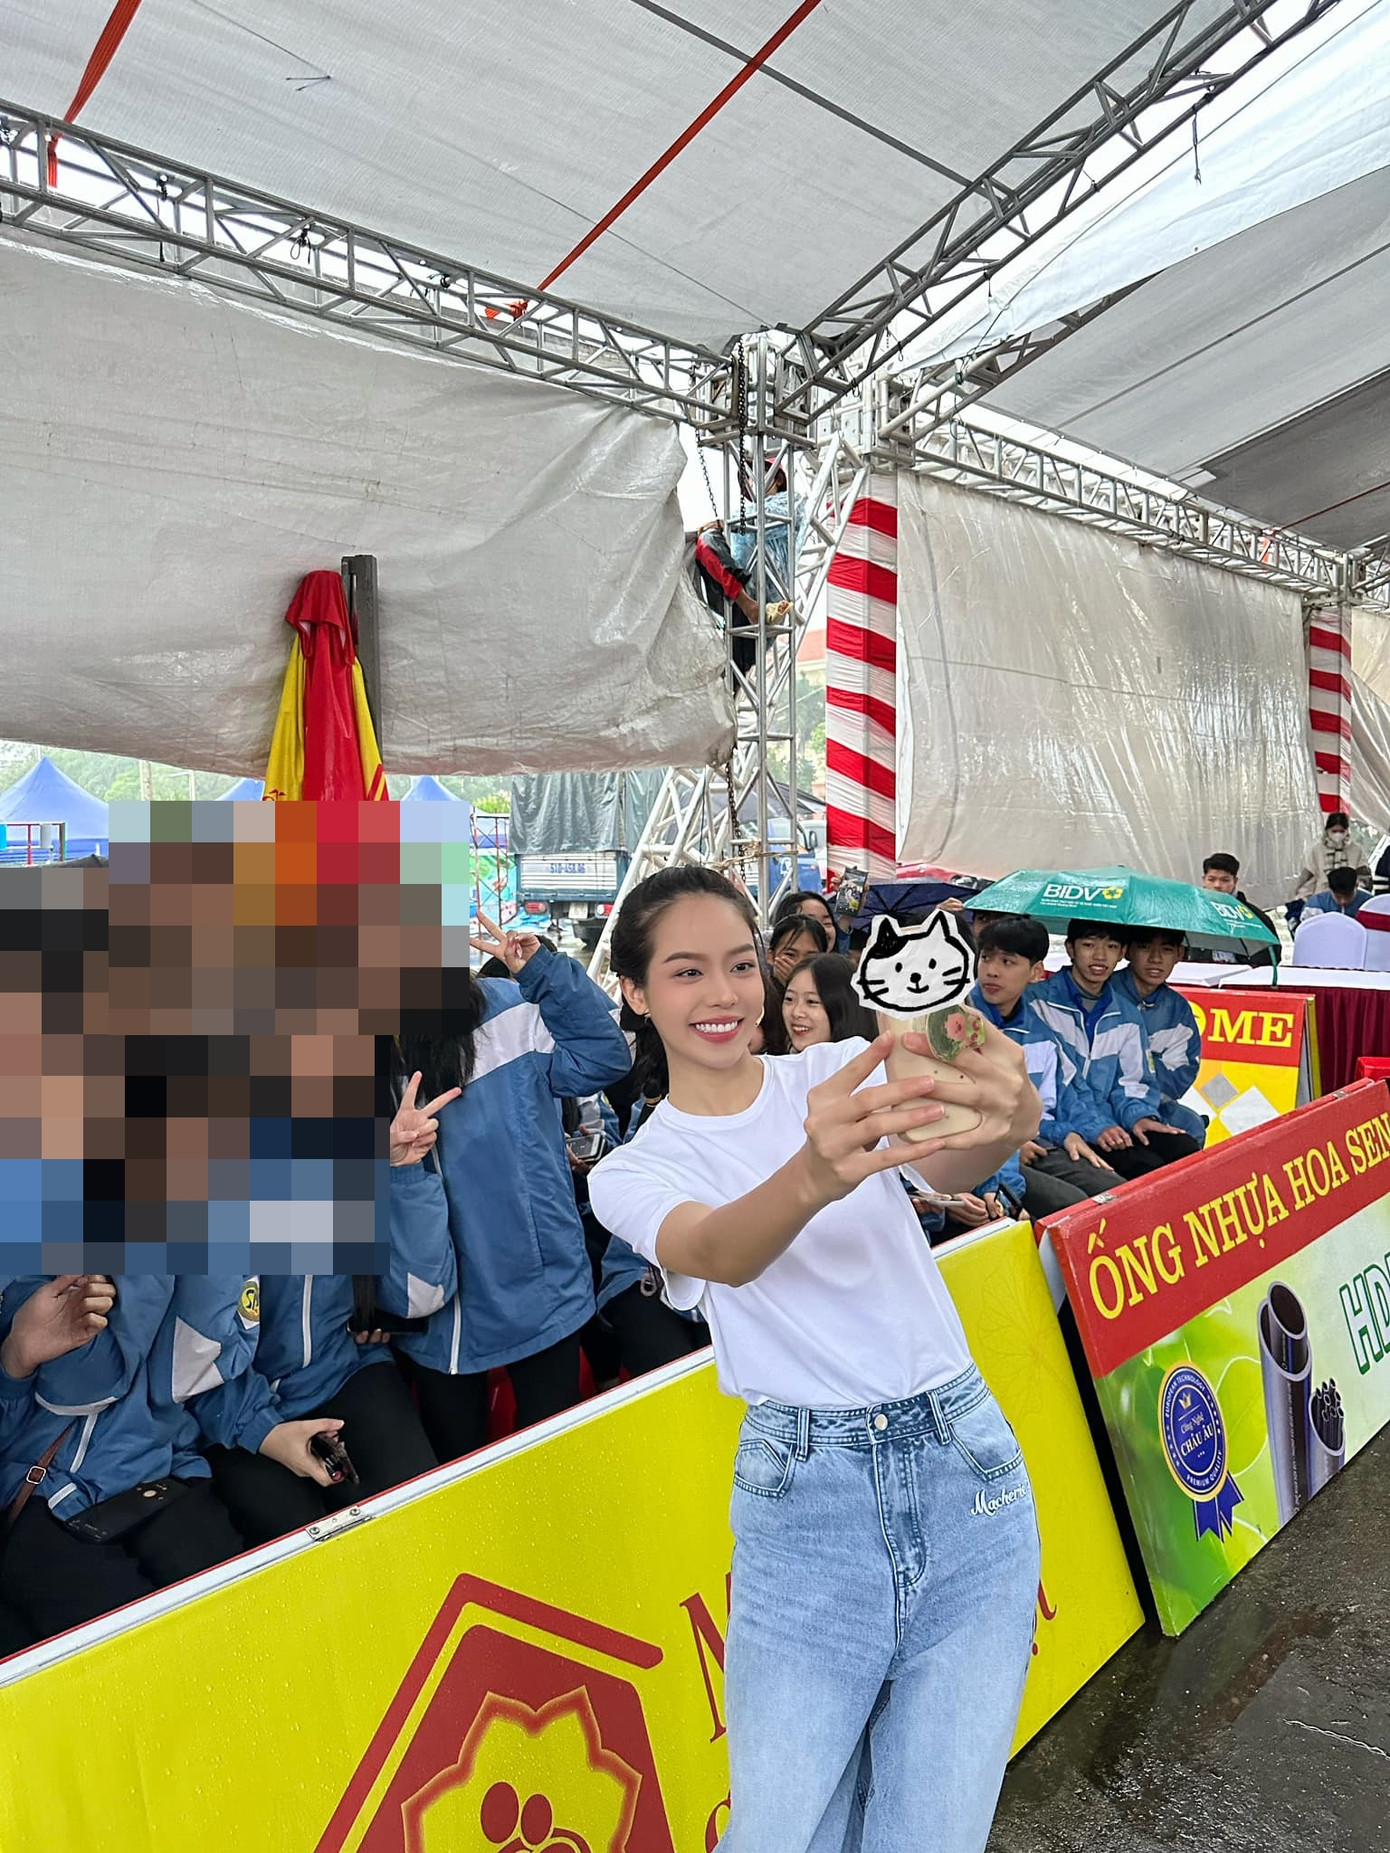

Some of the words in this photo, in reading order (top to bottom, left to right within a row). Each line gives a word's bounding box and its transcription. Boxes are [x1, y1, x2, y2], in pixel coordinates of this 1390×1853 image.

[1042, 883, 1103, 902] BIDV
[1210, 900, 1245, 921] BIDV
[1088, 1218, 1186, 1320] ỐNG
[1183, 1171, 1290, 1269] NHỰA
[1281, 1140, 1351, 1211] HOA
[1338, 1250, 1390, 1376] HD
[1164, 1379, 1178, 1418] EUROPEAN
[1186, 1473, 1210, 1487] PREMIUM
[1209, 1450, 1222, 1481] QUALITY
